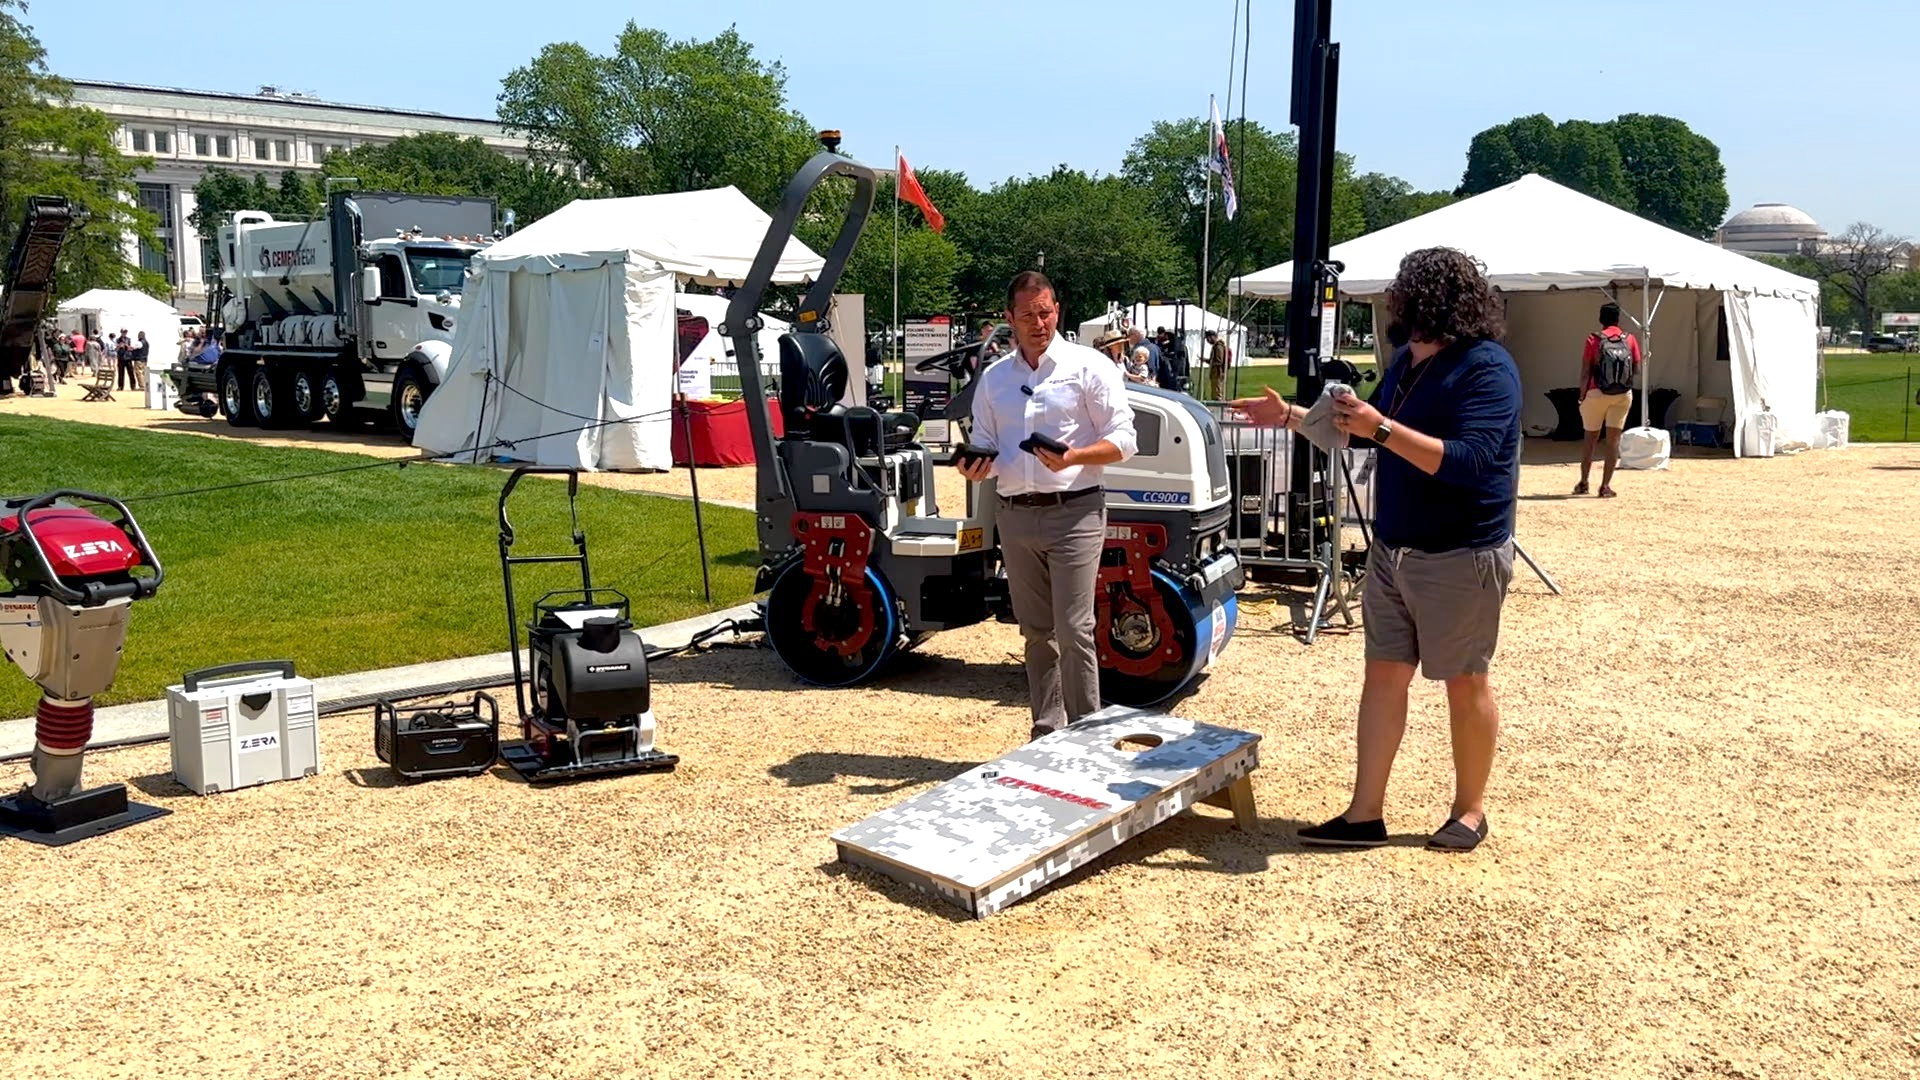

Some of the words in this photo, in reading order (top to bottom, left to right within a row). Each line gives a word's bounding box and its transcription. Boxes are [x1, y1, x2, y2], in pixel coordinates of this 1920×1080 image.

[272, 247, 316, 267] CEMENTECH
[1143, 492, 1179, 503] CC900
[1180, 494, 1188, 504] e
[241, 736, 277, 750] Z.ERA
[997, 776, 1112, 810] DYNAPAC
